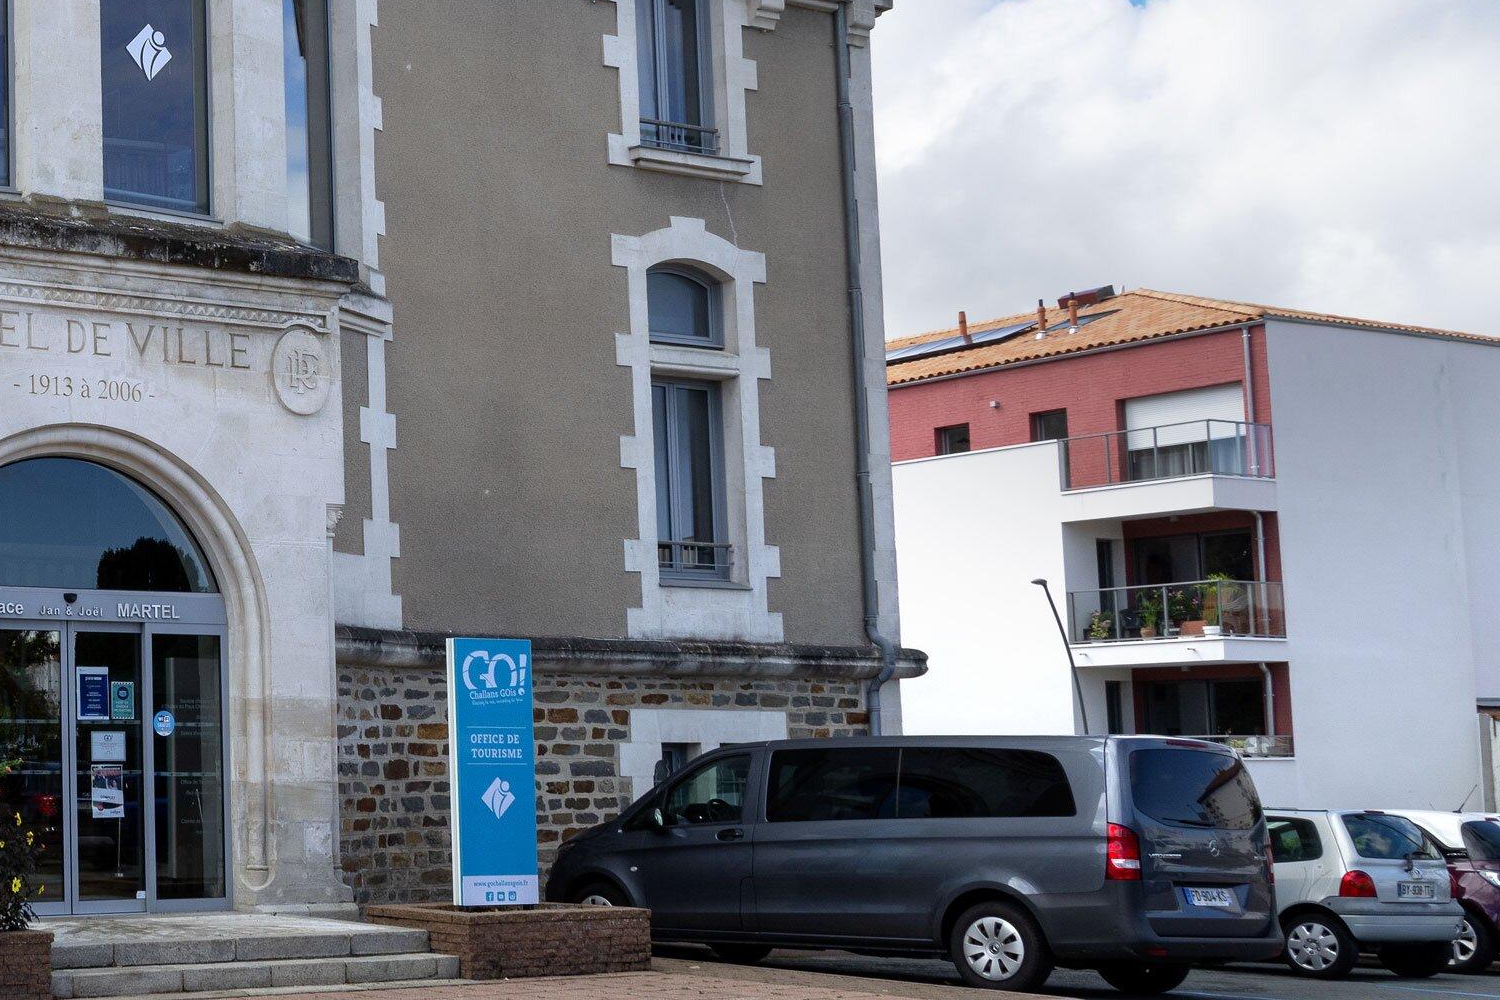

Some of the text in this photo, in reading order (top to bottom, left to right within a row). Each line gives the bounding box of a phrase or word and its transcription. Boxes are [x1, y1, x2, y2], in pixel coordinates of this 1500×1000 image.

[66, 319, 111, 357] DE
[125, 322, 250, 369] VILLE
[28, 374, 74, 397] 1913
[81, 378, 91, 398] à
[97, 379, 142, 402] 2006
[39, 605, 60, 615] Jan
[65, 605, 73, 616] &
[78, 606, 103, 617] Joël
[117, 603, 180, 619] MARTEL
[469, 690, 498, 700] Challans
[470, 734, 520, 744] OFFICE DE
[471, 748, 523, 759] TOURISME
